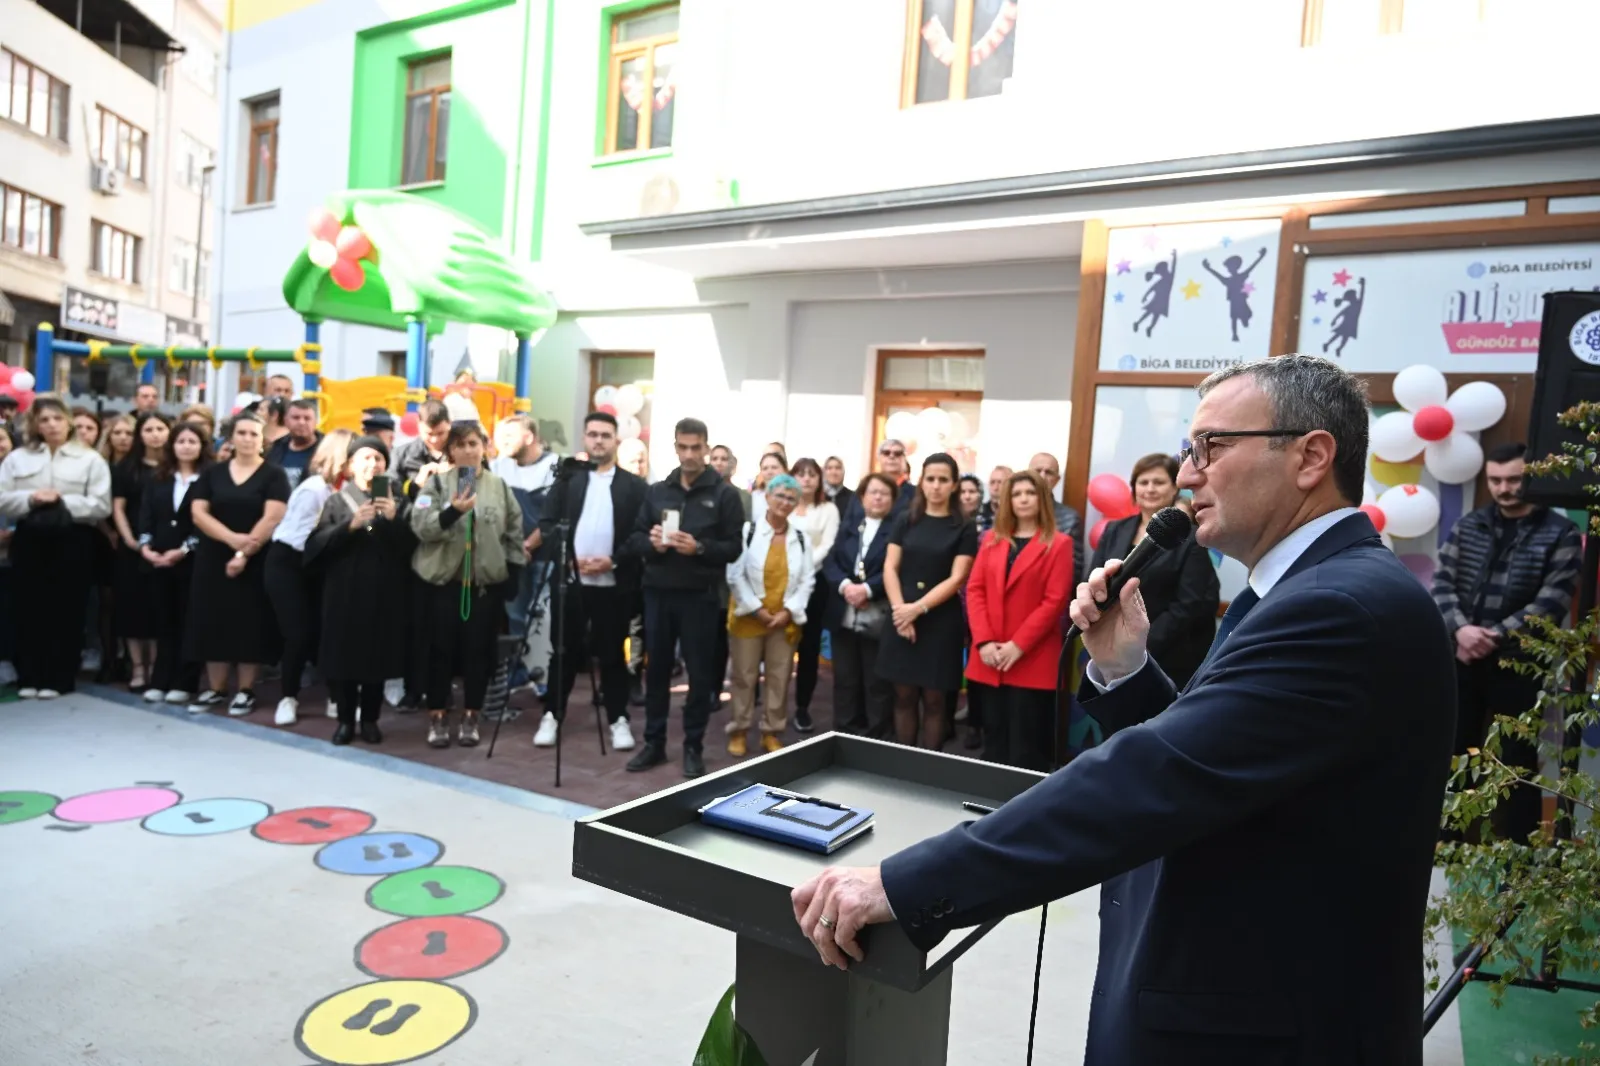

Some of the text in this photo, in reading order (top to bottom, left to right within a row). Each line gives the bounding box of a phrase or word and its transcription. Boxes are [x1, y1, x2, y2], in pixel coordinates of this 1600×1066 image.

[1489, 258, 1593, 274] BİGA BELEDİYESİ
[1456, 336, 1541, 349] GÜNDÜZ BA
[1140, 356, 1171, 369] BİGA
